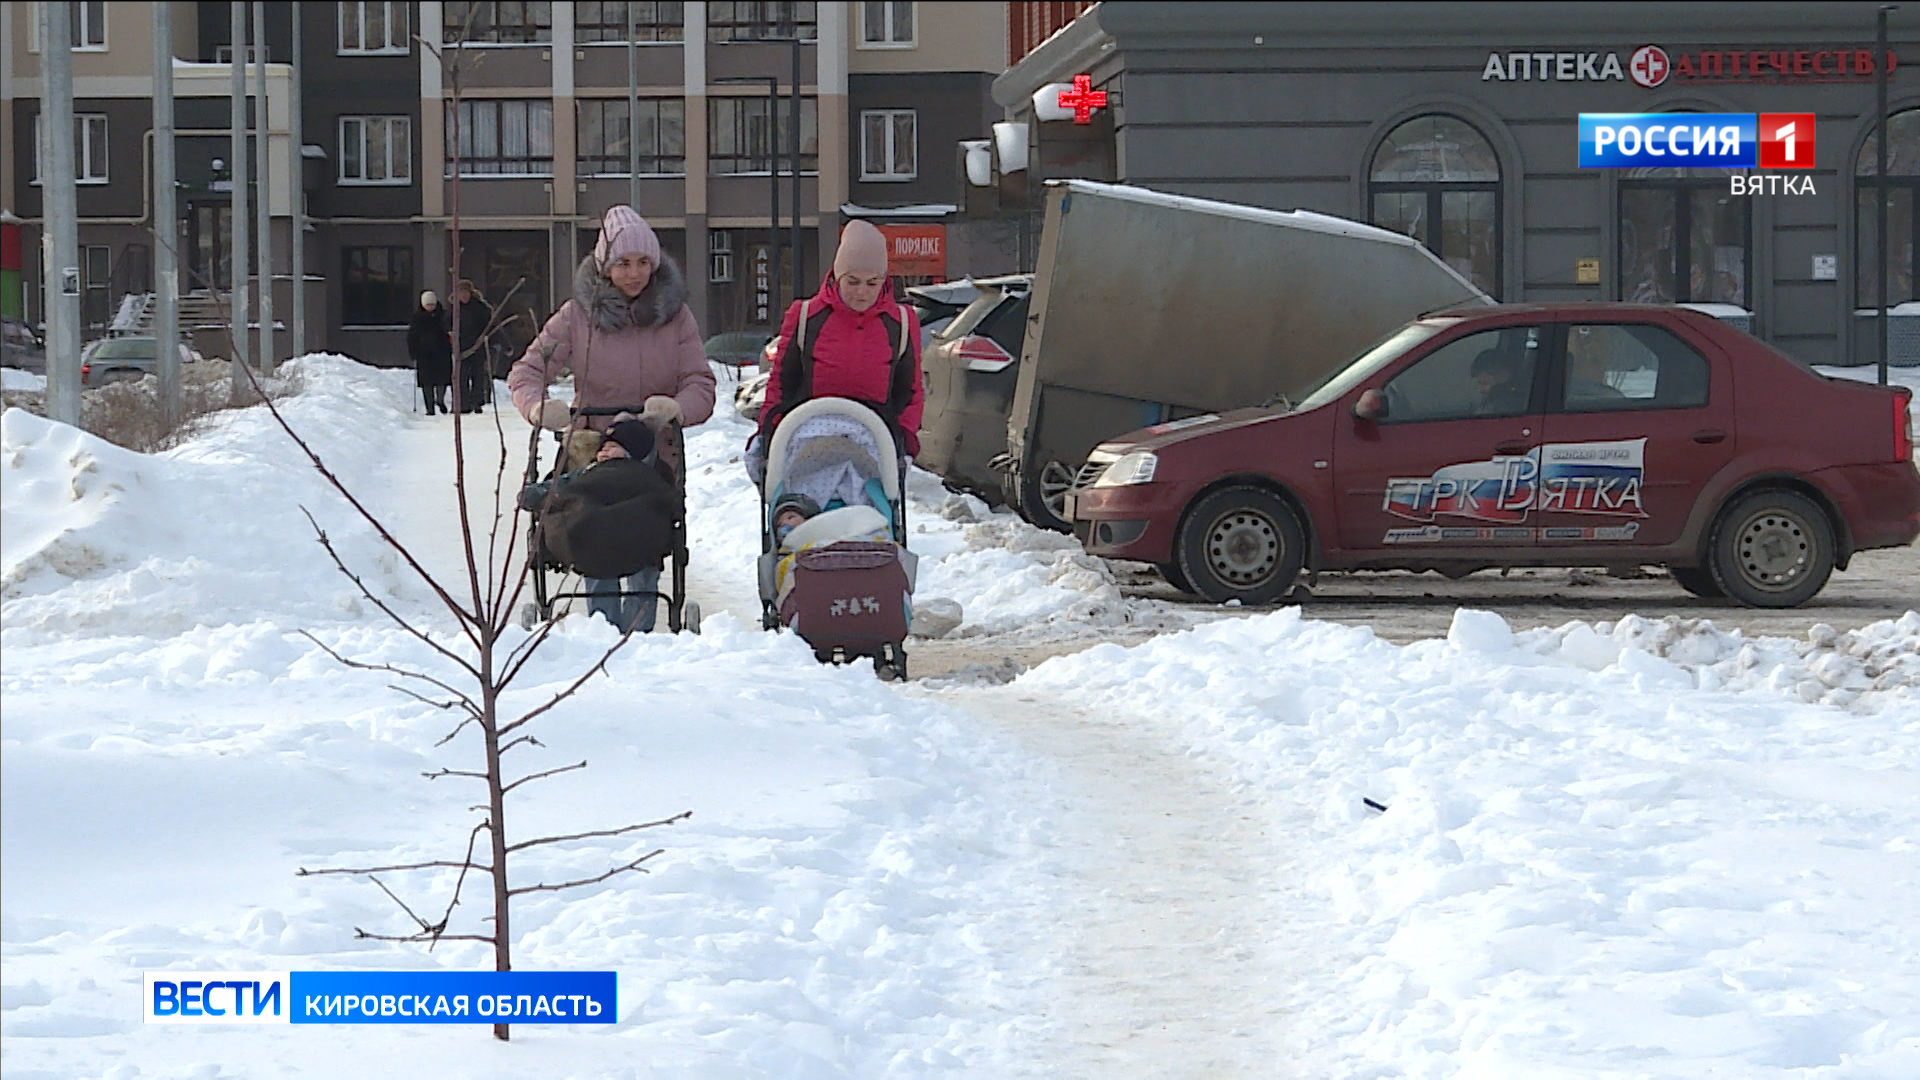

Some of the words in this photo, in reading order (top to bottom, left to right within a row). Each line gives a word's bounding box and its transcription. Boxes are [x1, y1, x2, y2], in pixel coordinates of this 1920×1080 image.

[1481, 52, 1625, 81] АПТЕКА
[895, 237, 941, 256] ПОРЯДКЕ
[757, 247, 769, 320] АКЦИЯ
[1382, 478, 1485, 512] ГТРК
